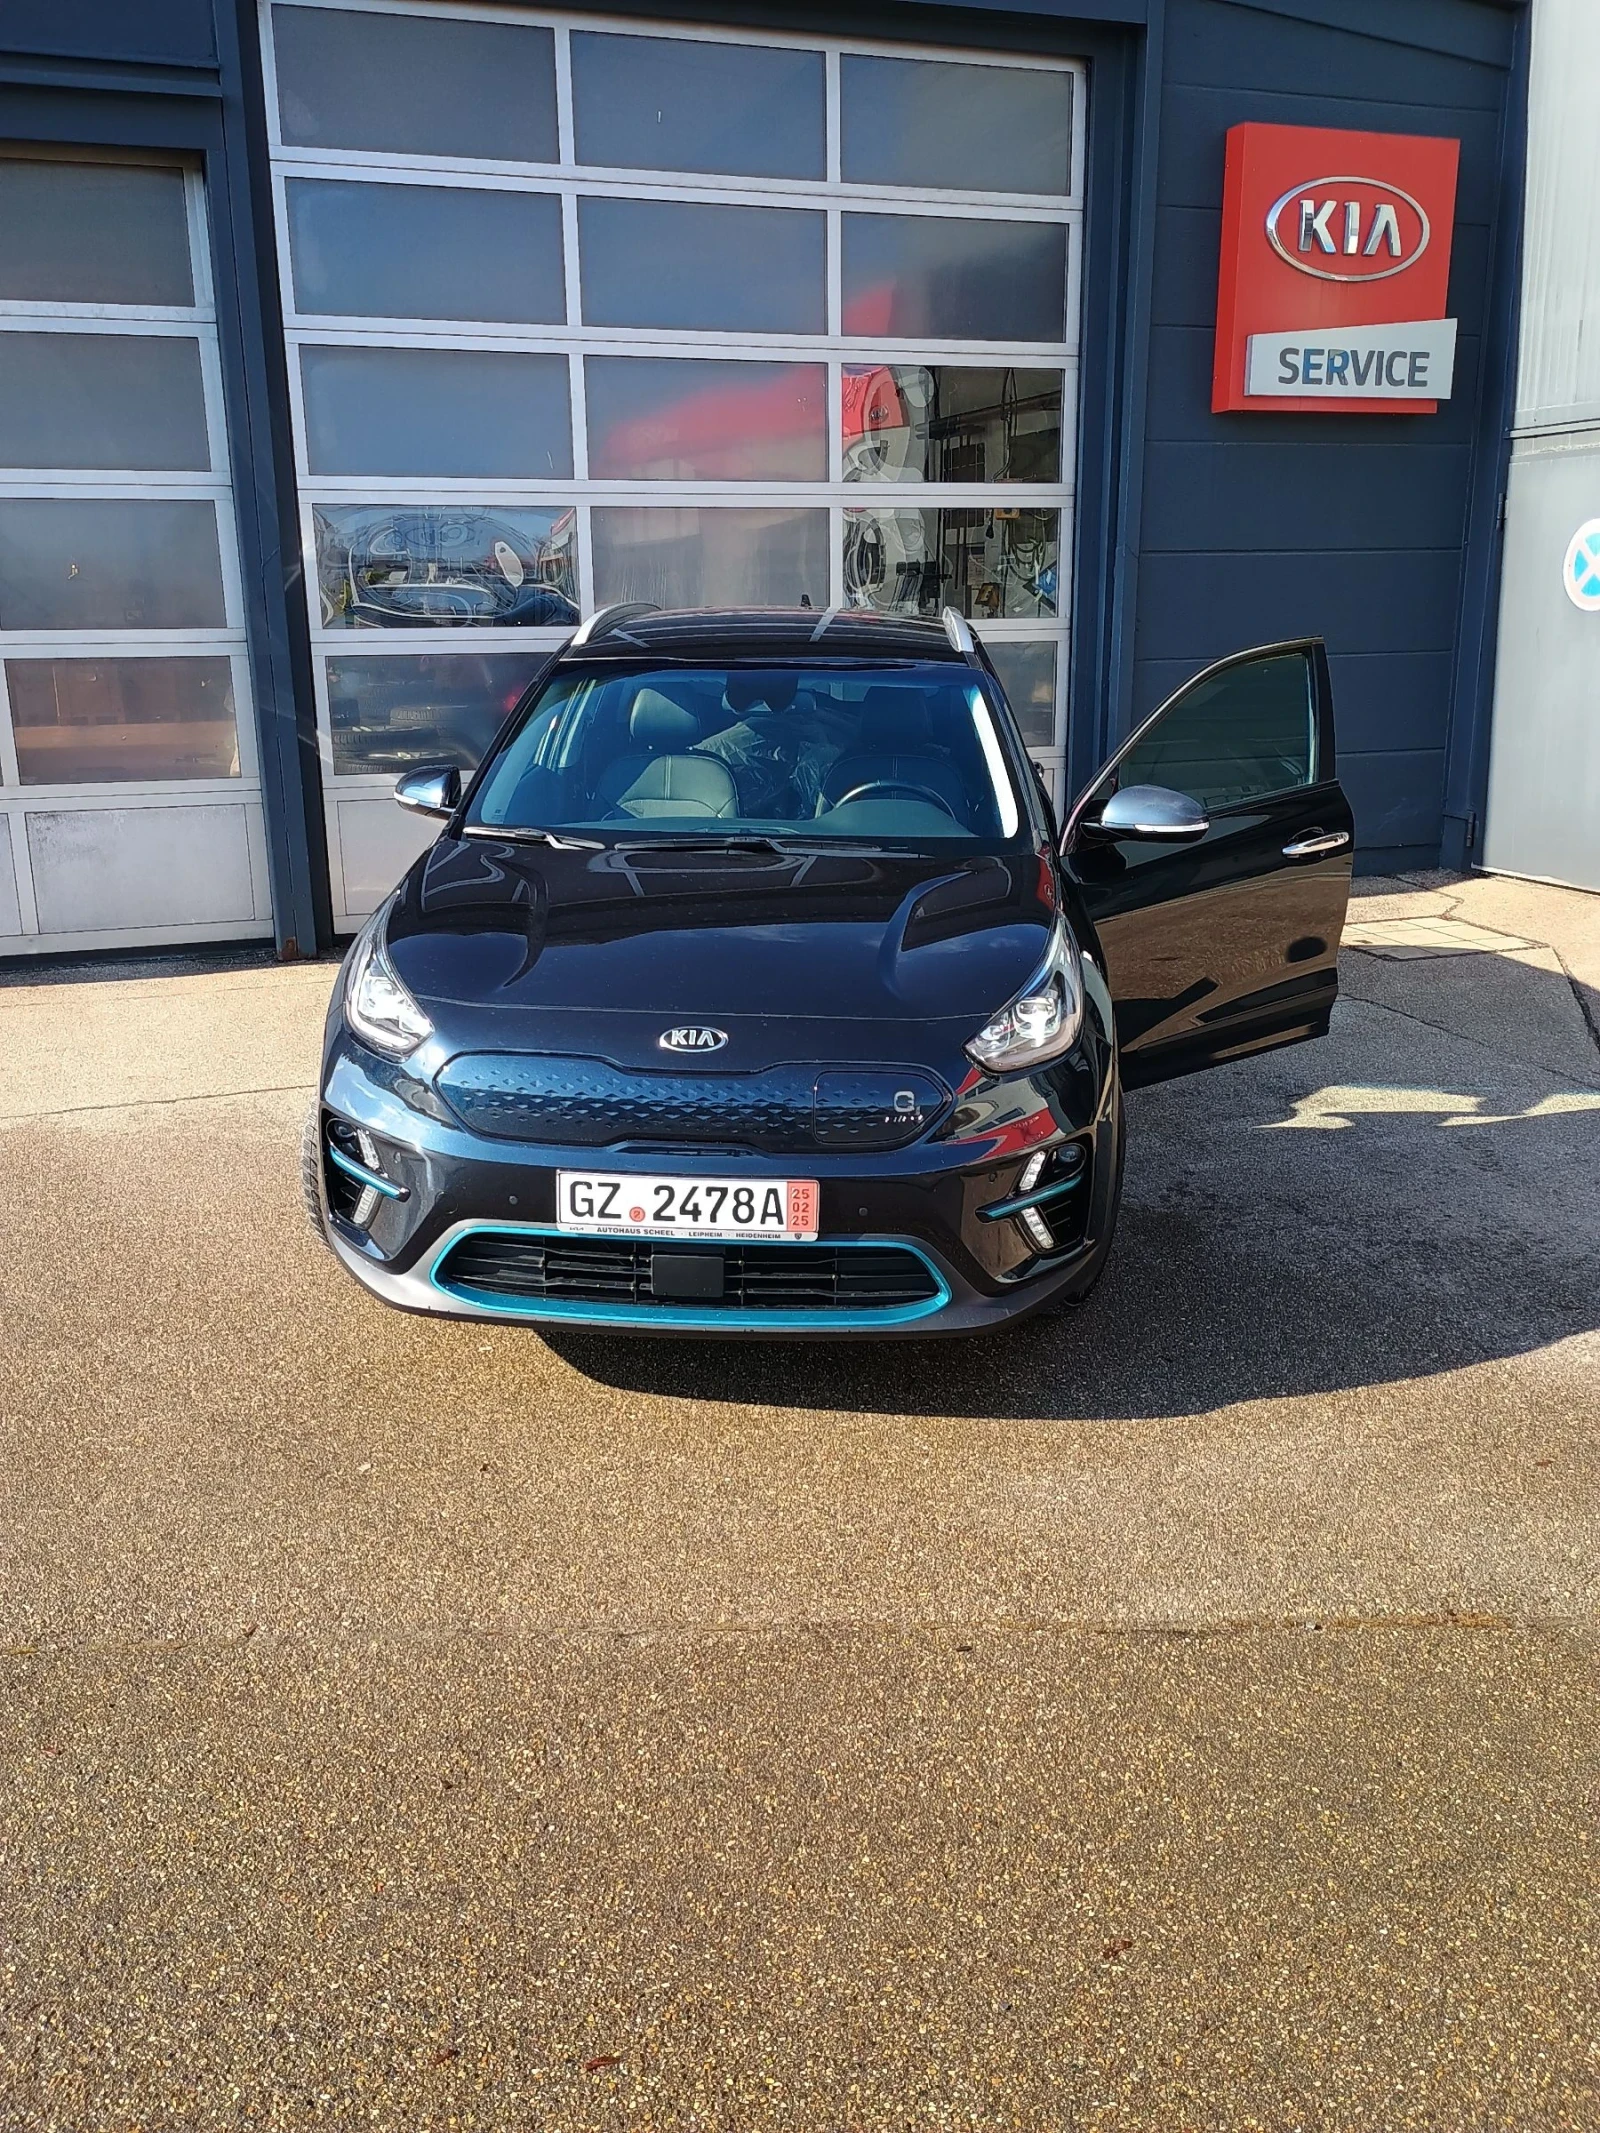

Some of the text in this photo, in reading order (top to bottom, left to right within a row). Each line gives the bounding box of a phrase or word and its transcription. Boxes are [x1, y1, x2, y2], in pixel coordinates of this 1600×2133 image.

[1298, 199, 1401, 257] KIA
[1278, 347, 1430, 388] SERVICE
[671, 1029, 714, 1046] KIA
[792, 1188, 810, 1200] 25
[569, 1180, 784, 1225] GZ 2478A
[792, 1202, 810, 1213] 02
[792, 1215, 809, 1226] 25
[596, 1226, 641, 1235] AUTOHAUS
[643, 1228, 675, 1236] SCHEEL
